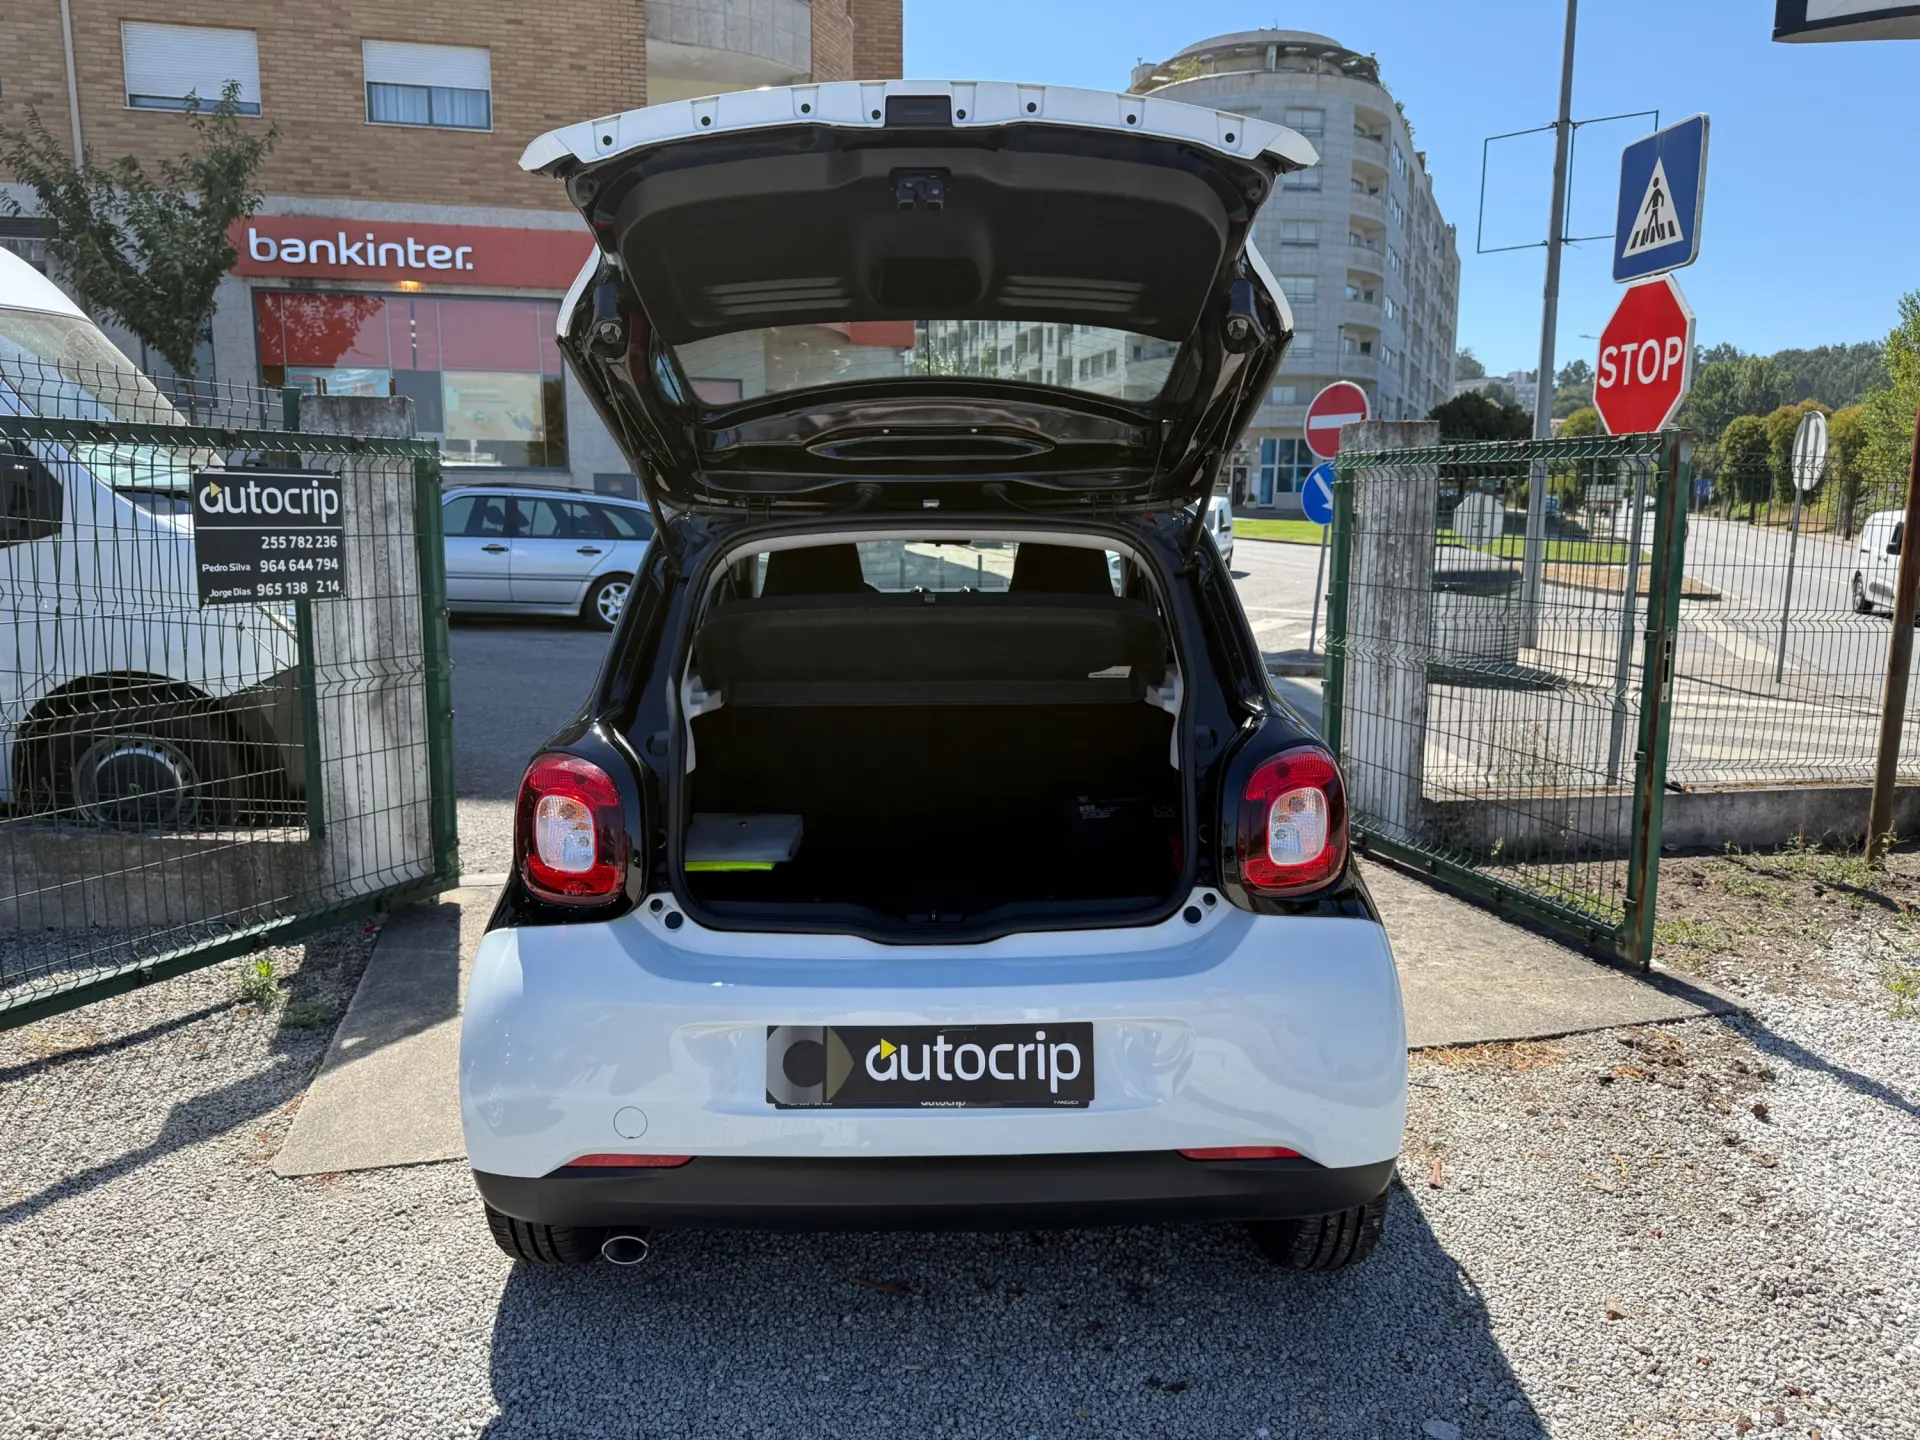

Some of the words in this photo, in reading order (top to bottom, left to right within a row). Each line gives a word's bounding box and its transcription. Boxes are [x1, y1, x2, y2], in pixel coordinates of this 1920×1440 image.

[248, 228, 474, 270] bankinter.
[1598, 336, 1683, 388] STOP
[199, 480, 339, 523] autocrip
[261, 536, 287, 549] 255
[289, 536, 313, 549] 782
[315, 535, 338, 548] 236
[202, 564, 228, 572] Pedro
[229, 563, 251, 572] Silva
[259, 560, 286, 573] 964
[288, 559, 314, 572] 644
[316, 558, 339, 571] 794
[209, 589, 232, 598] Jorge
[233, 587, 251, 596] Dias
[256, 583, 282, 596] 965
[285, 582, 308, 595] 138
[316, 580, 340, 593] 214
[865, 1030, 1081, 1094] autocrip
